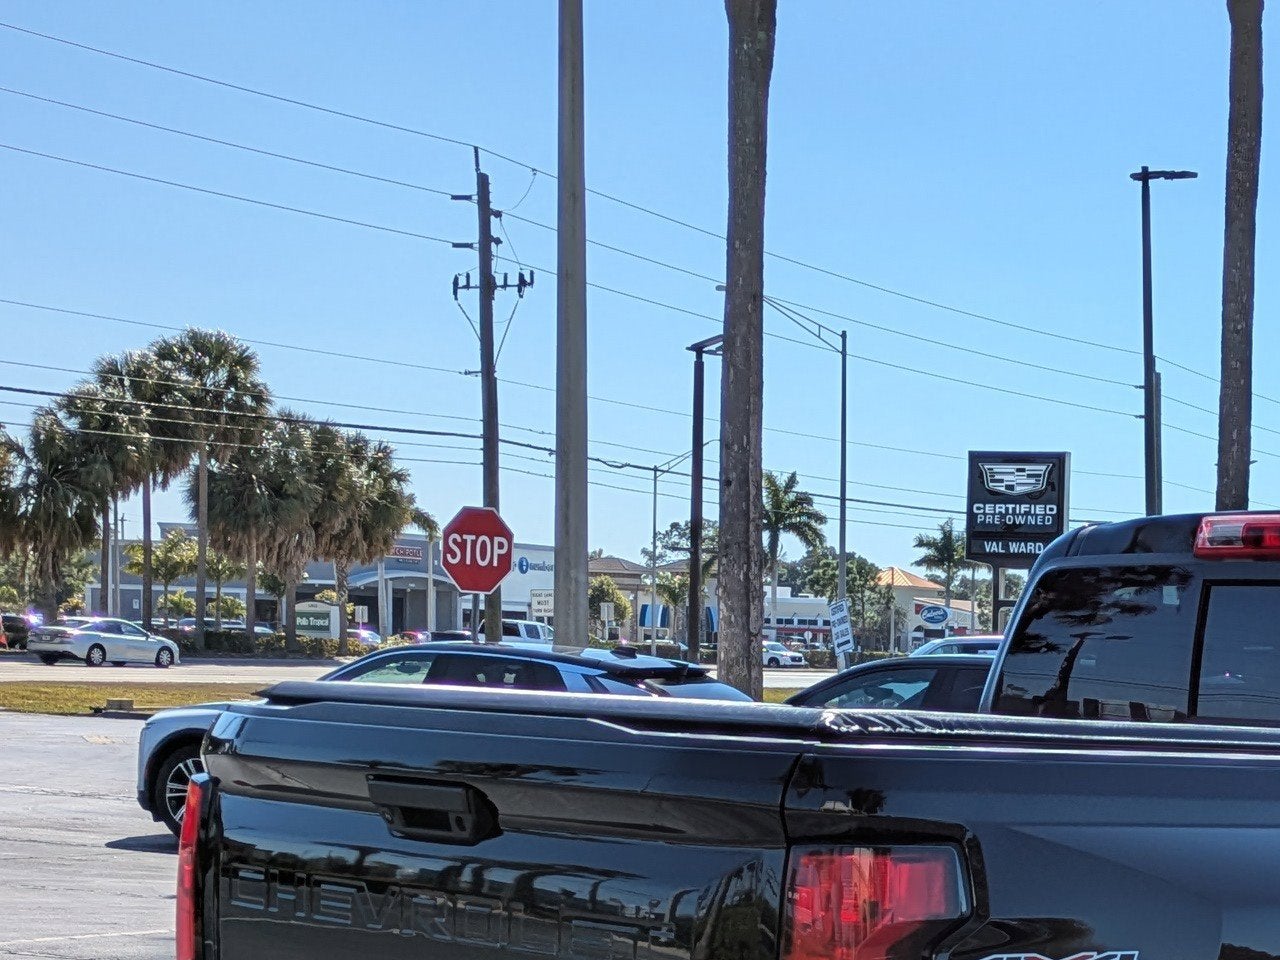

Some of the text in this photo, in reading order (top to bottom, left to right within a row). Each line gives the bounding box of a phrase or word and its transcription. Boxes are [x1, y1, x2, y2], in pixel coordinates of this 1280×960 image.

[973, 503, 1057, 514] CERTIFIED
[977, 515, 1053, 525] PRE-OWNED
[446, 533, 509, 567] STOP
[984, 542, 1044, 554] VAL WARD
